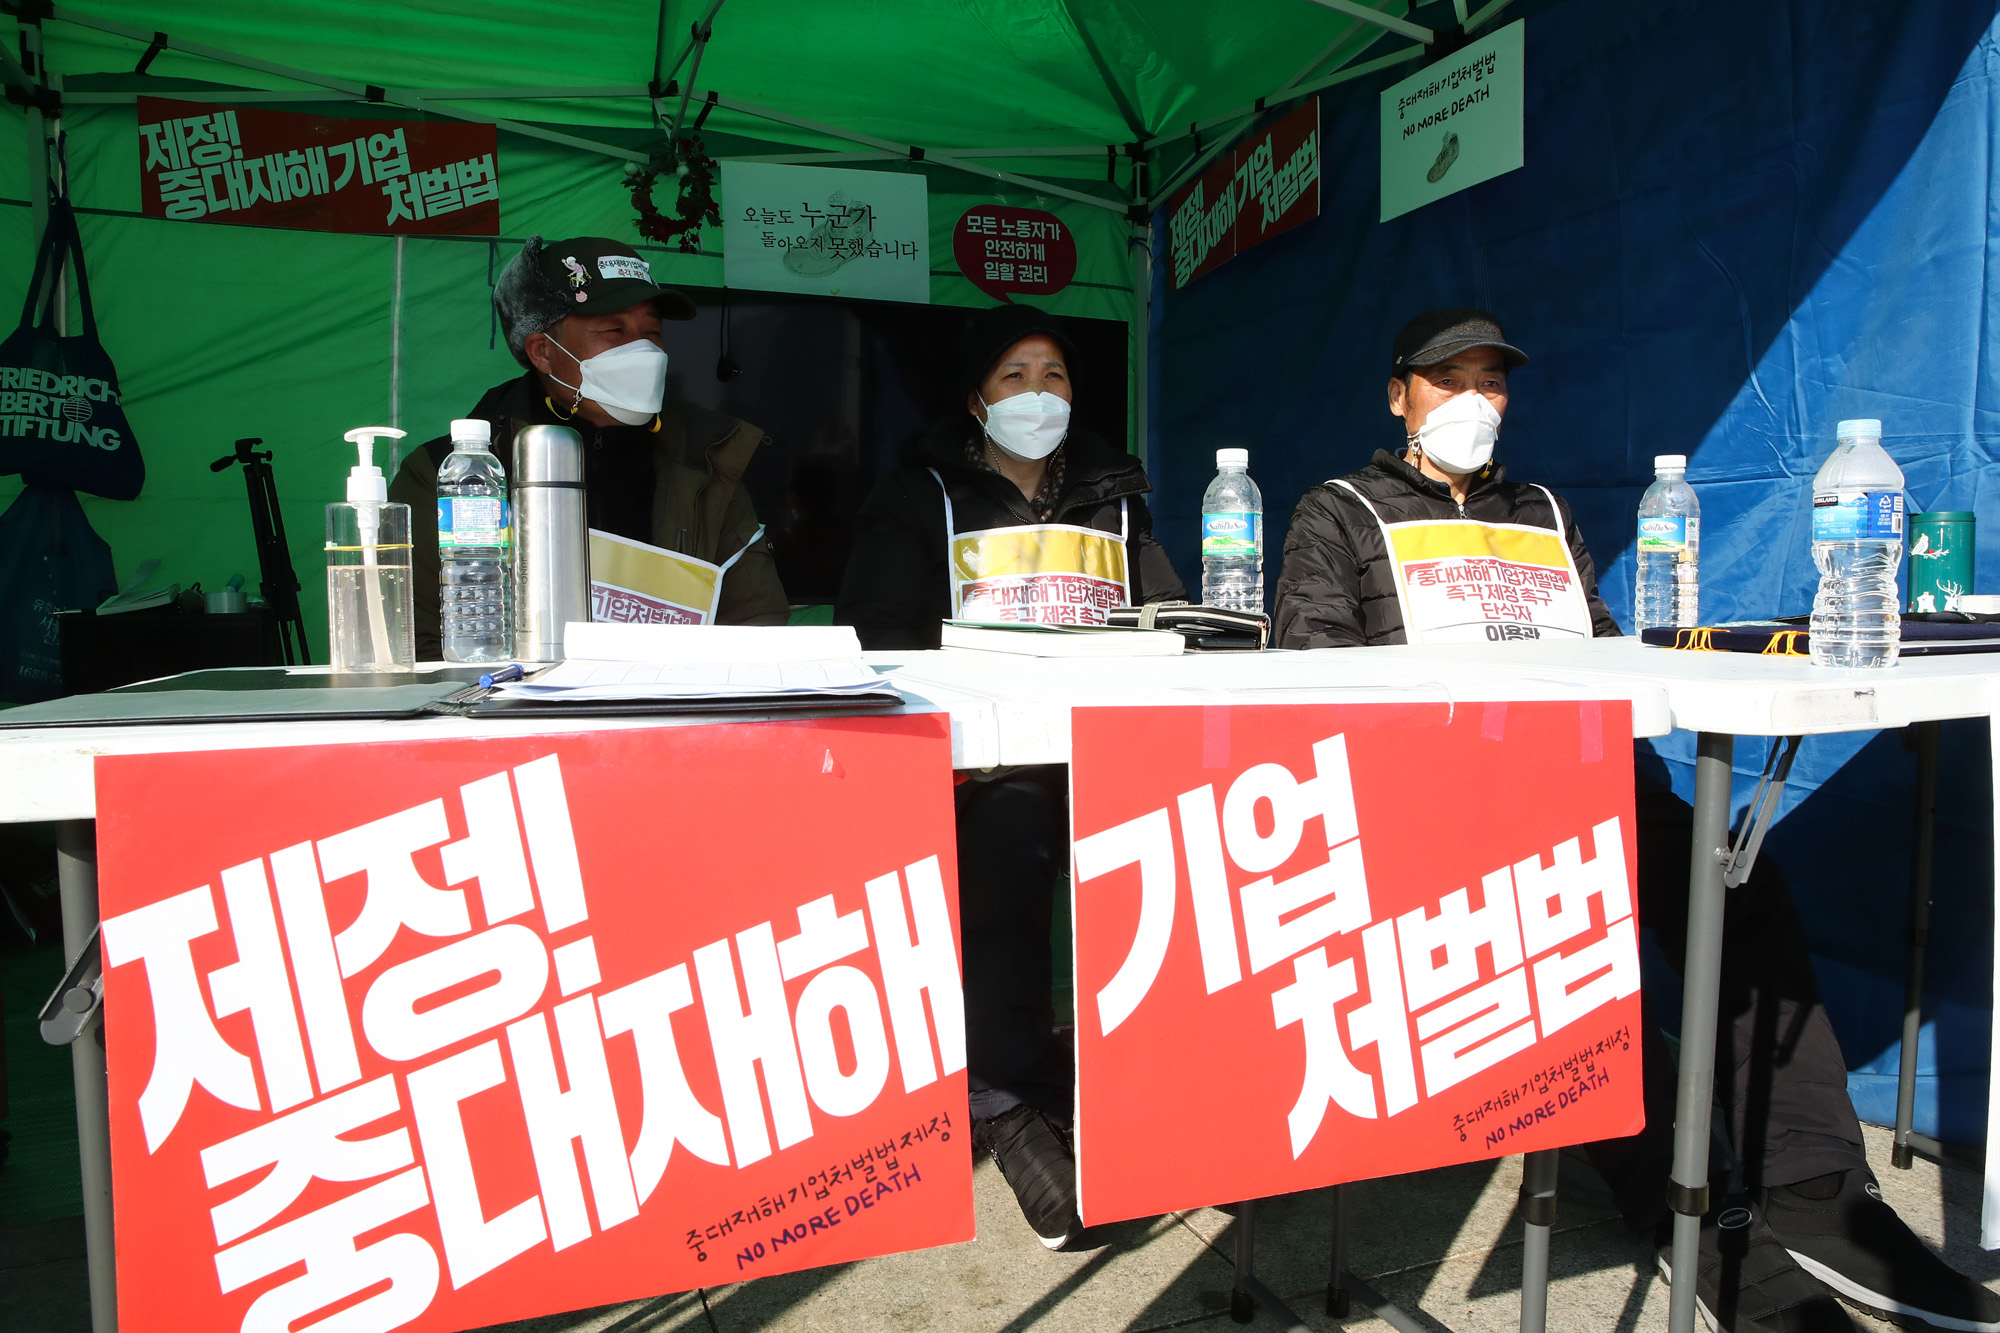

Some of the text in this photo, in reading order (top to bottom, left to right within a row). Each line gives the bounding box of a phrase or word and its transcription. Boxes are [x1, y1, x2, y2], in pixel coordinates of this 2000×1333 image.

[1402, 84, 1490, 140] NO MORE DEATH
[382, 153, 499, 227] 처벌법
[1259, 129, 1318, 235] 처벌법
[743, 202, 877, 232] 오늘도 누군가
[967, 215, 1060, 241] 모든 노동자가
[761, 231, 919, 261] 돌아오지 못했습니다
[985, 239, 1045, 261] 안전하게
[984, 262, 1048, 284] 일할 권리
[0, 366, 121, 407] RIEDRICH
[0, 391, 67, 418] BERT
[0, 415, 121, 451] TIFTUNG
[1446, 584, 1553, 607] 즉각 제정 촉구
[1481, 602, 1533, 622] 단식자
[1074, 732, 1372, 1037] 기업
[1270, 815, 1641, 1161] 처벌법
[199, 854, 968, 1333] 중대재해
[1486, 1067, 1610, 1150] NO MORE DEATH
[736, 1163, 922, 1271] NO MORE DEATH
